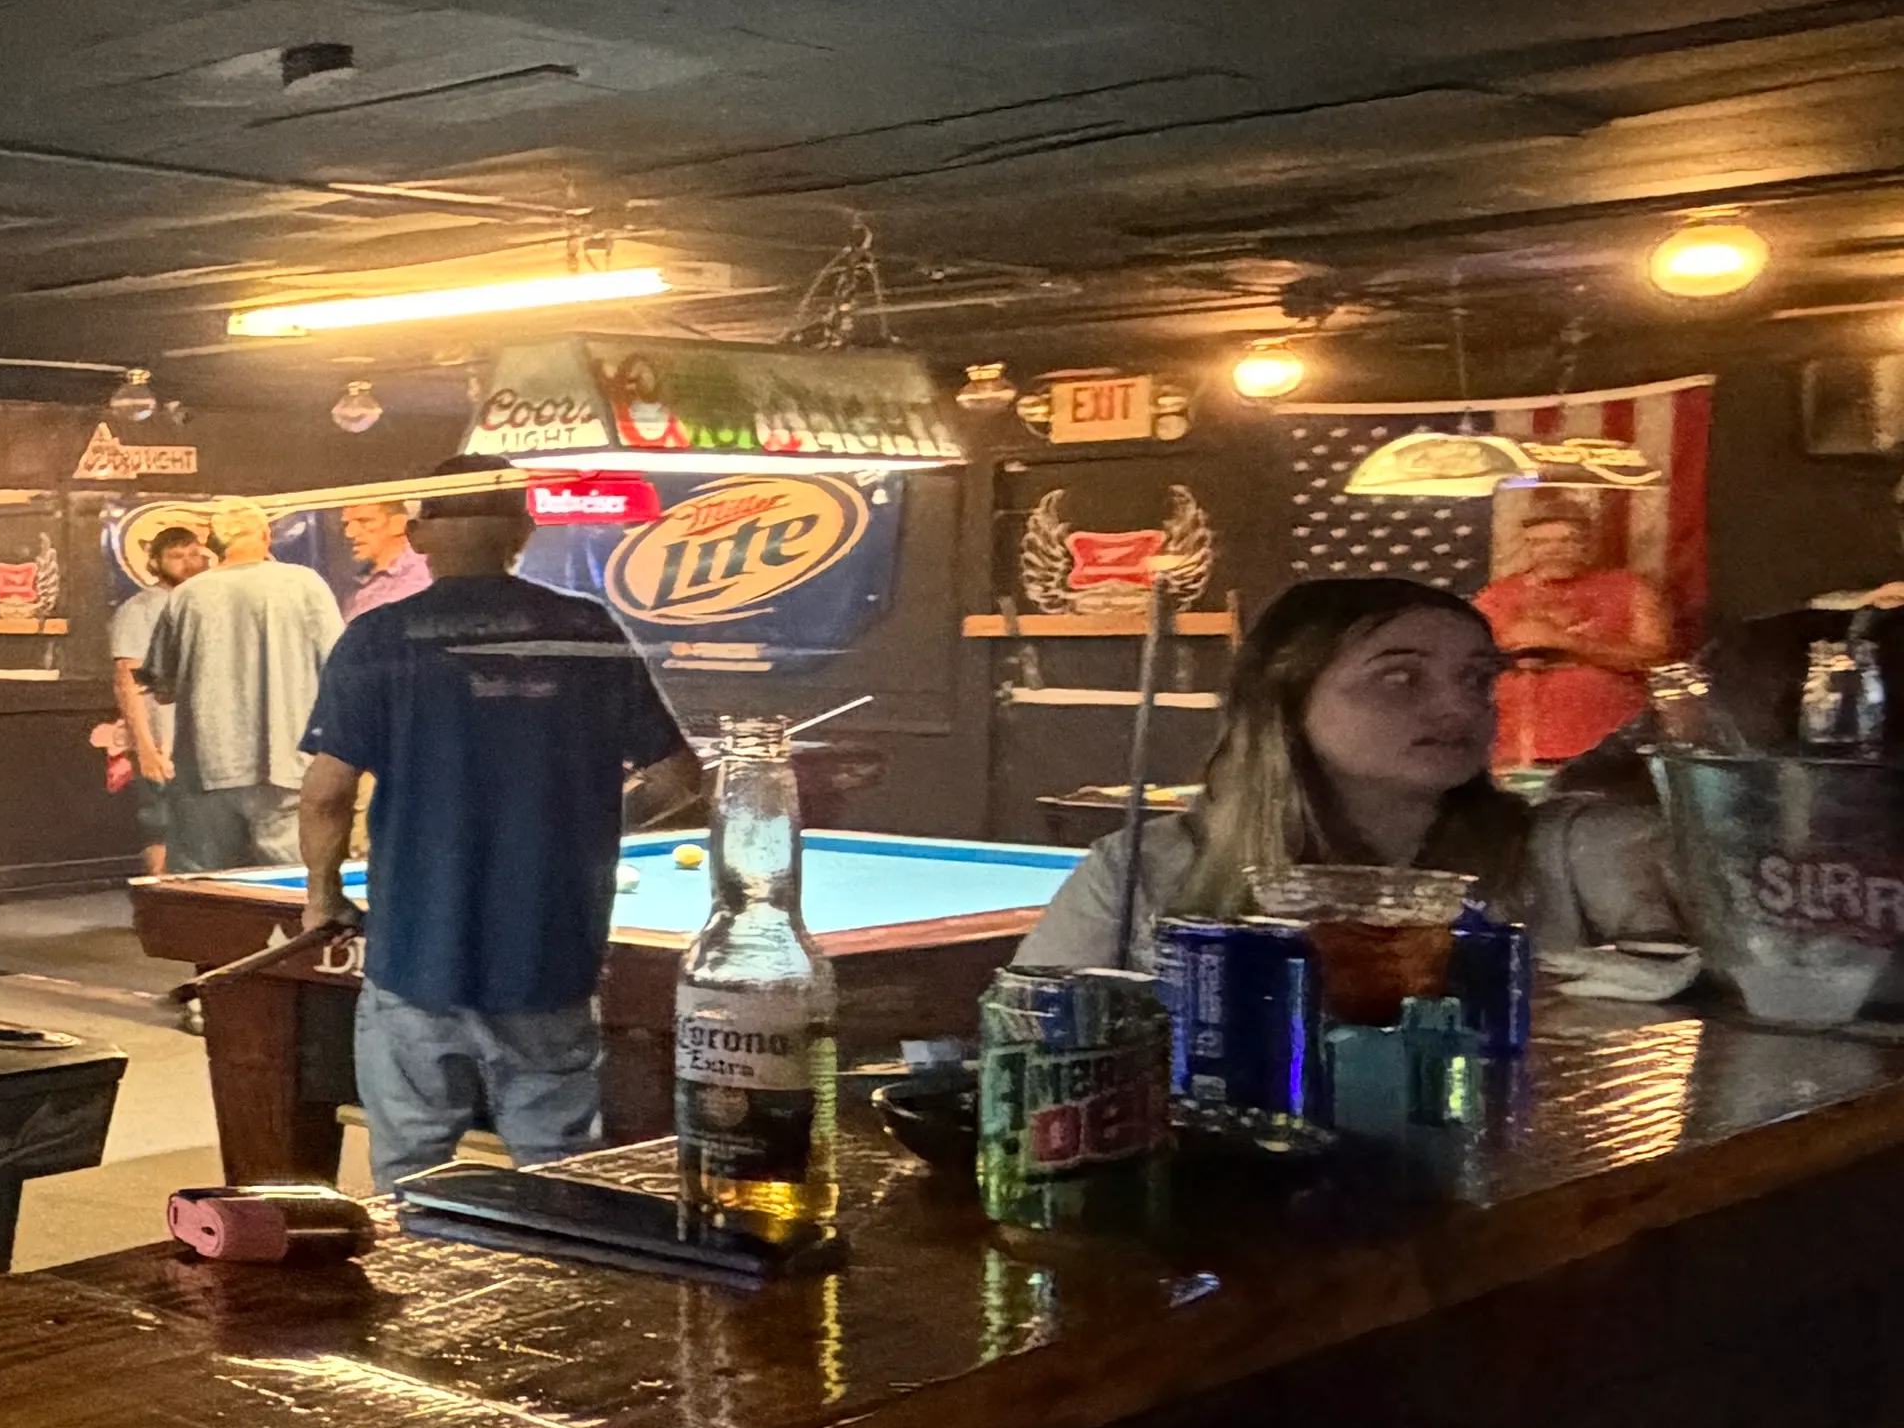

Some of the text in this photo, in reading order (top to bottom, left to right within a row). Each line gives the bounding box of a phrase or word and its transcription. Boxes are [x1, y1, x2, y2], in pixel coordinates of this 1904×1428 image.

[1071, 382, 1136, 423] EXIT
[646, 513, 822, 612] Lite
[677, 1016, 790, 1057] Corona
[688, 1049, 755, 1078] Extra
